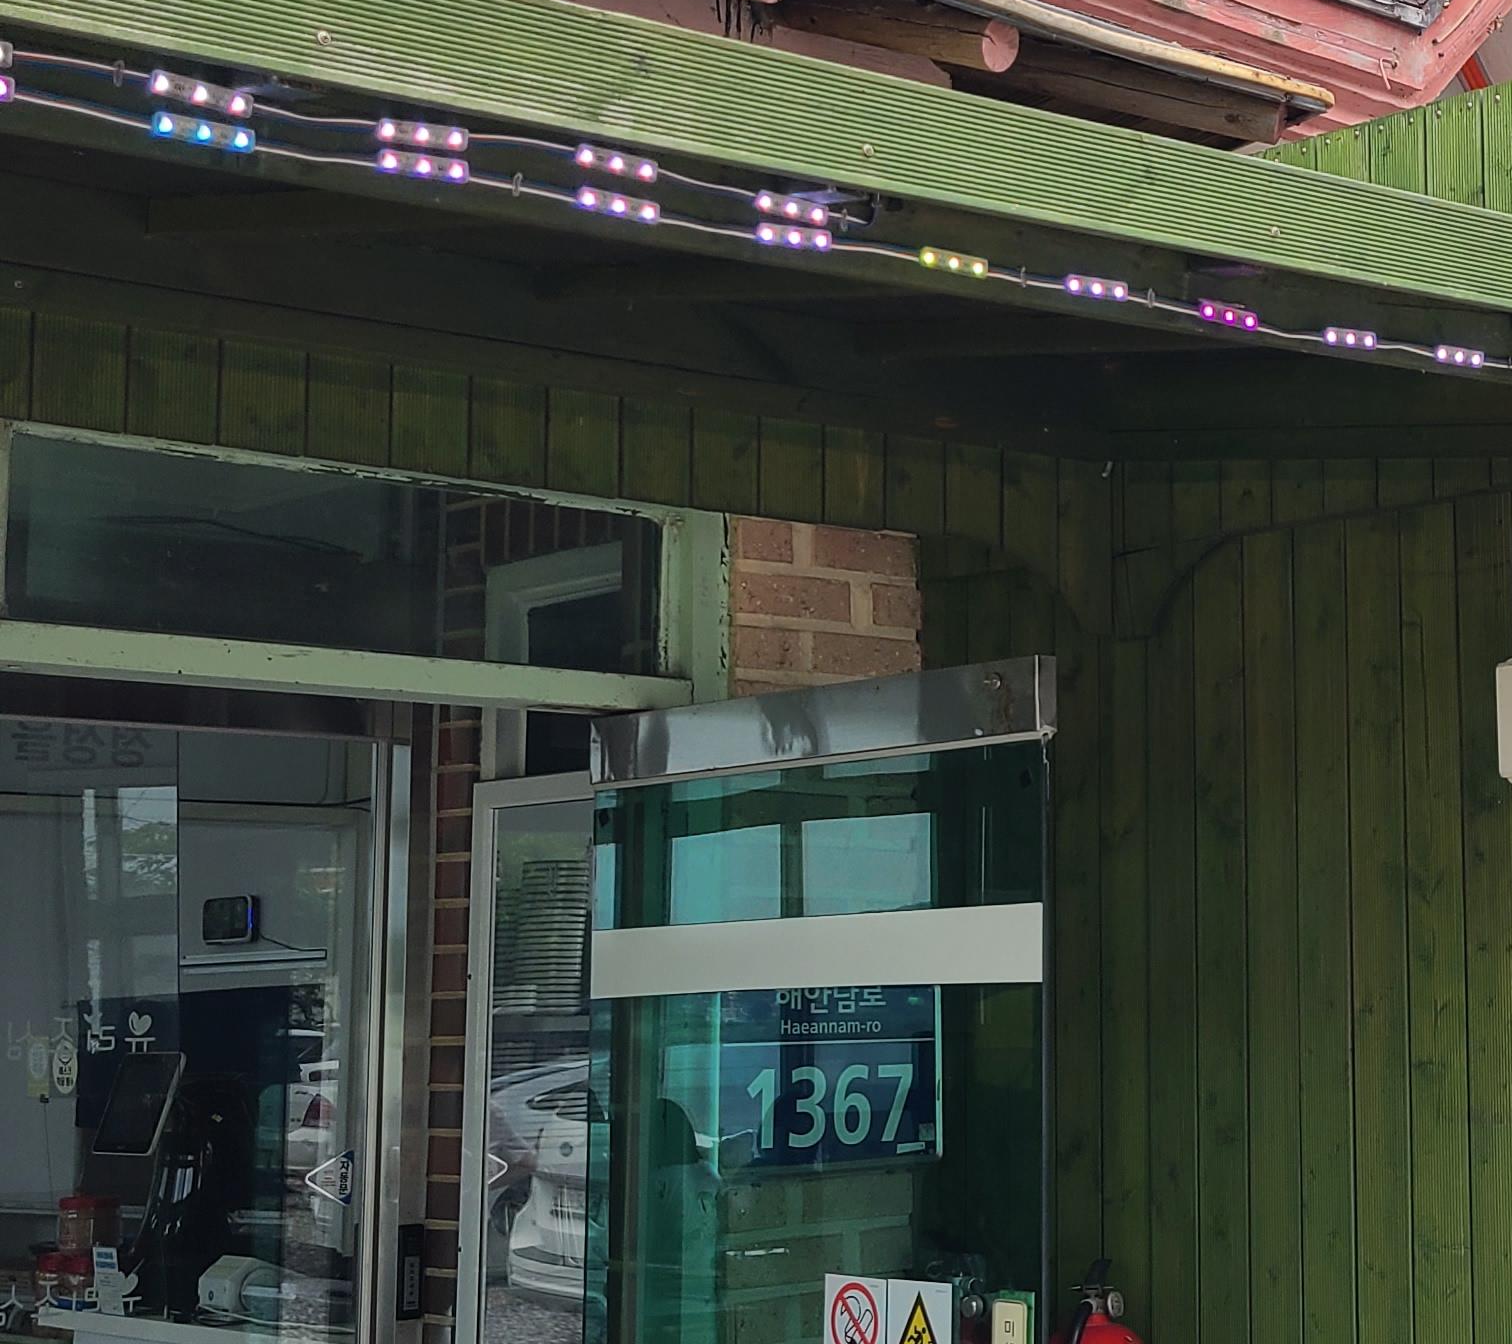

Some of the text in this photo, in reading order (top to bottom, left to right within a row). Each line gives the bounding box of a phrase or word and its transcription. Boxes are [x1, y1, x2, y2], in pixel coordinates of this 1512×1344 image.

[780, 1018, 882, 1035] Haeannam-ro
[746, 1064, 914, 1149] 1367
[338, 1159, 350, 1196] 자동문
